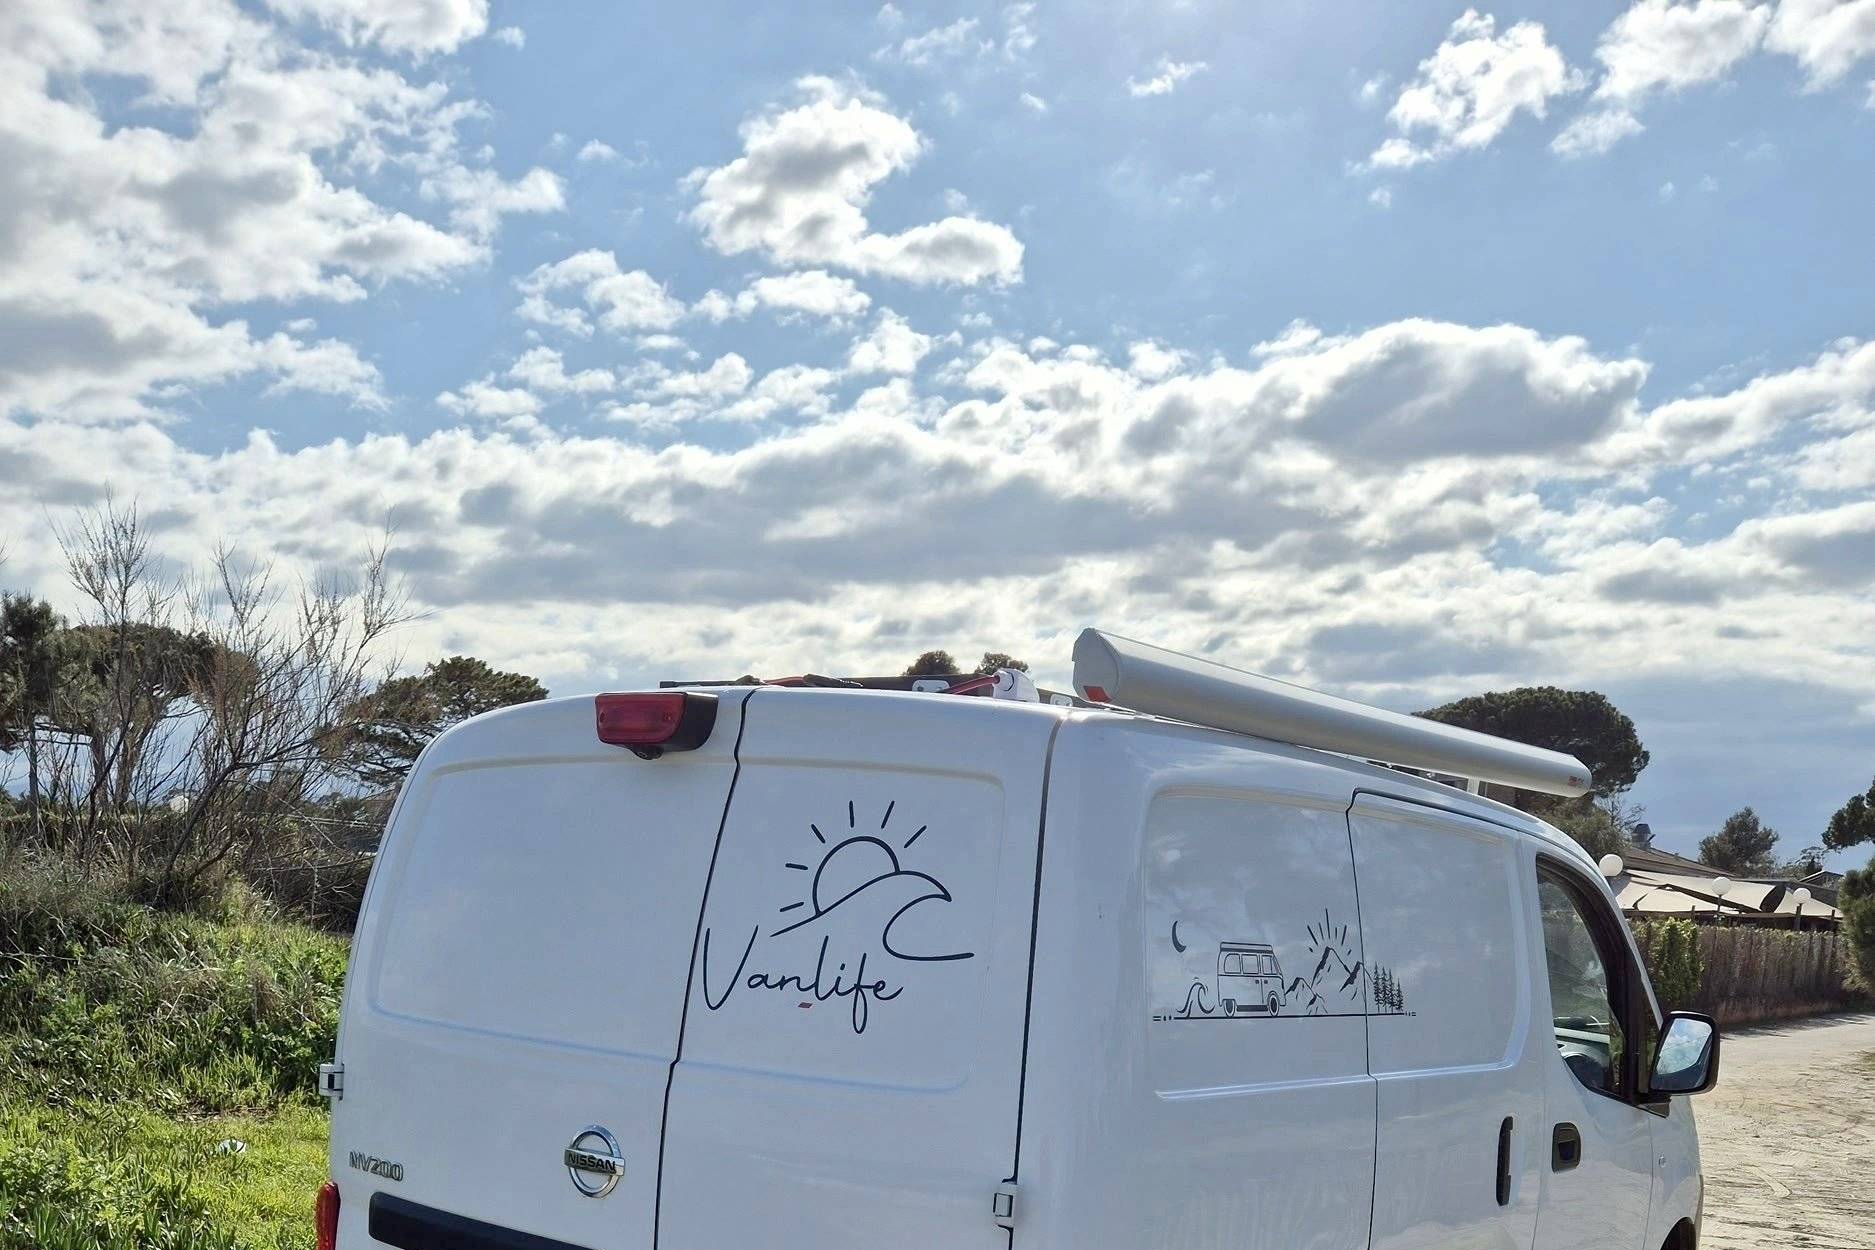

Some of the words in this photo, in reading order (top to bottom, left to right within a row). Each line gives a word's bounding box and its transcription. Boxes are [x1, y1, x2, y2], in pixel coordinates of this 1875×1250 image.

[702, 924, 904, 1035] Vanlife
[349, 1150, 404, 1182] NV200
[568, 1152, 617, 1174] NISSAN
